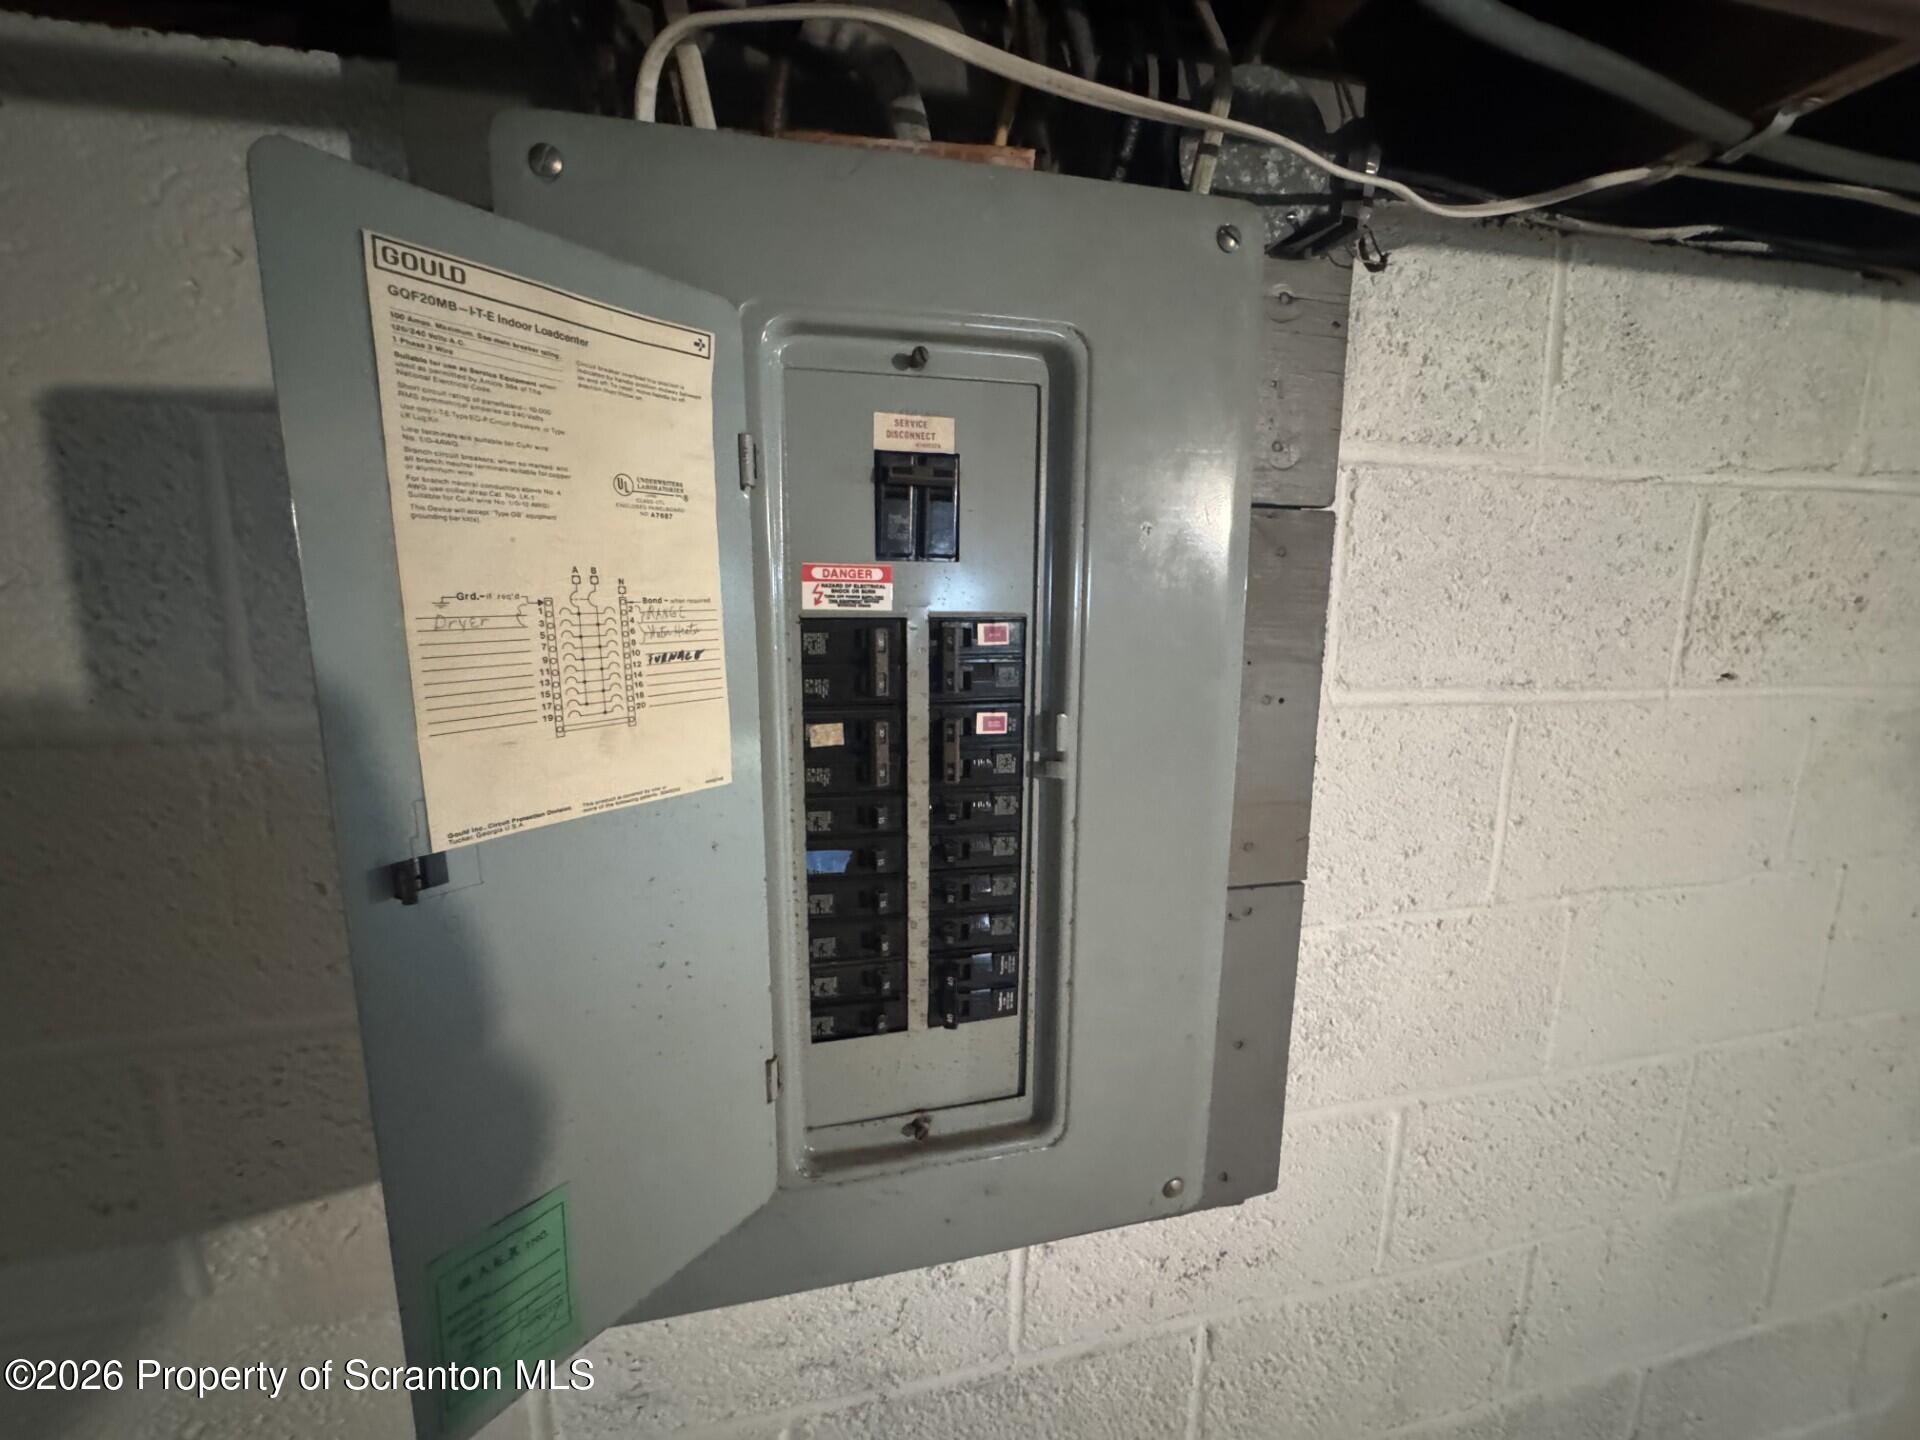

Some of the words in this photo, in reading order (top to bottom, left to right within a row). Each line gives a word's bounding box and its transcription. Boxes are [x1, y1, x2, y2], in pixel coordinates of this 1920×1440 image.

[381, 245, 466, 285] GOULD
[498, 313, 532, 332] Indoor
[535, 323, 589, 347] Loadcenter
[428, 332, 448, 342] Volts
[400, 336, 426, 349] Phase
[434, 345, 454, 355] Wire
[429, 358, 441, 366] for
[469, 367, 497, 379] Service
[498, 373, 537, 388] Equipment
[894, 418, 928, 429] SERVICE
[886, 430, 936, 441] DISCONNECT
[405, 473, 420, 482] For
[617, 477, 630, 493] UL
[427, 504, 452, 513] Device
[572, 566, 579, 574] A
[822, 568, 873, 579] DANGER
[618, 578, 625, 586] N
[632, 649, 641, 657] 10
[540, 667, 550, 676] 11
[540, 679, 550, 687] 13
[540, 691, 551, 699] 15
[636, 702, 646, 710] 20
[447, 829, 470, 839] Gould
[487, 820, 510, 829] Circuit
[512, 810, 546, 823] Protection
[476, 828, 503, 839] Georgia
